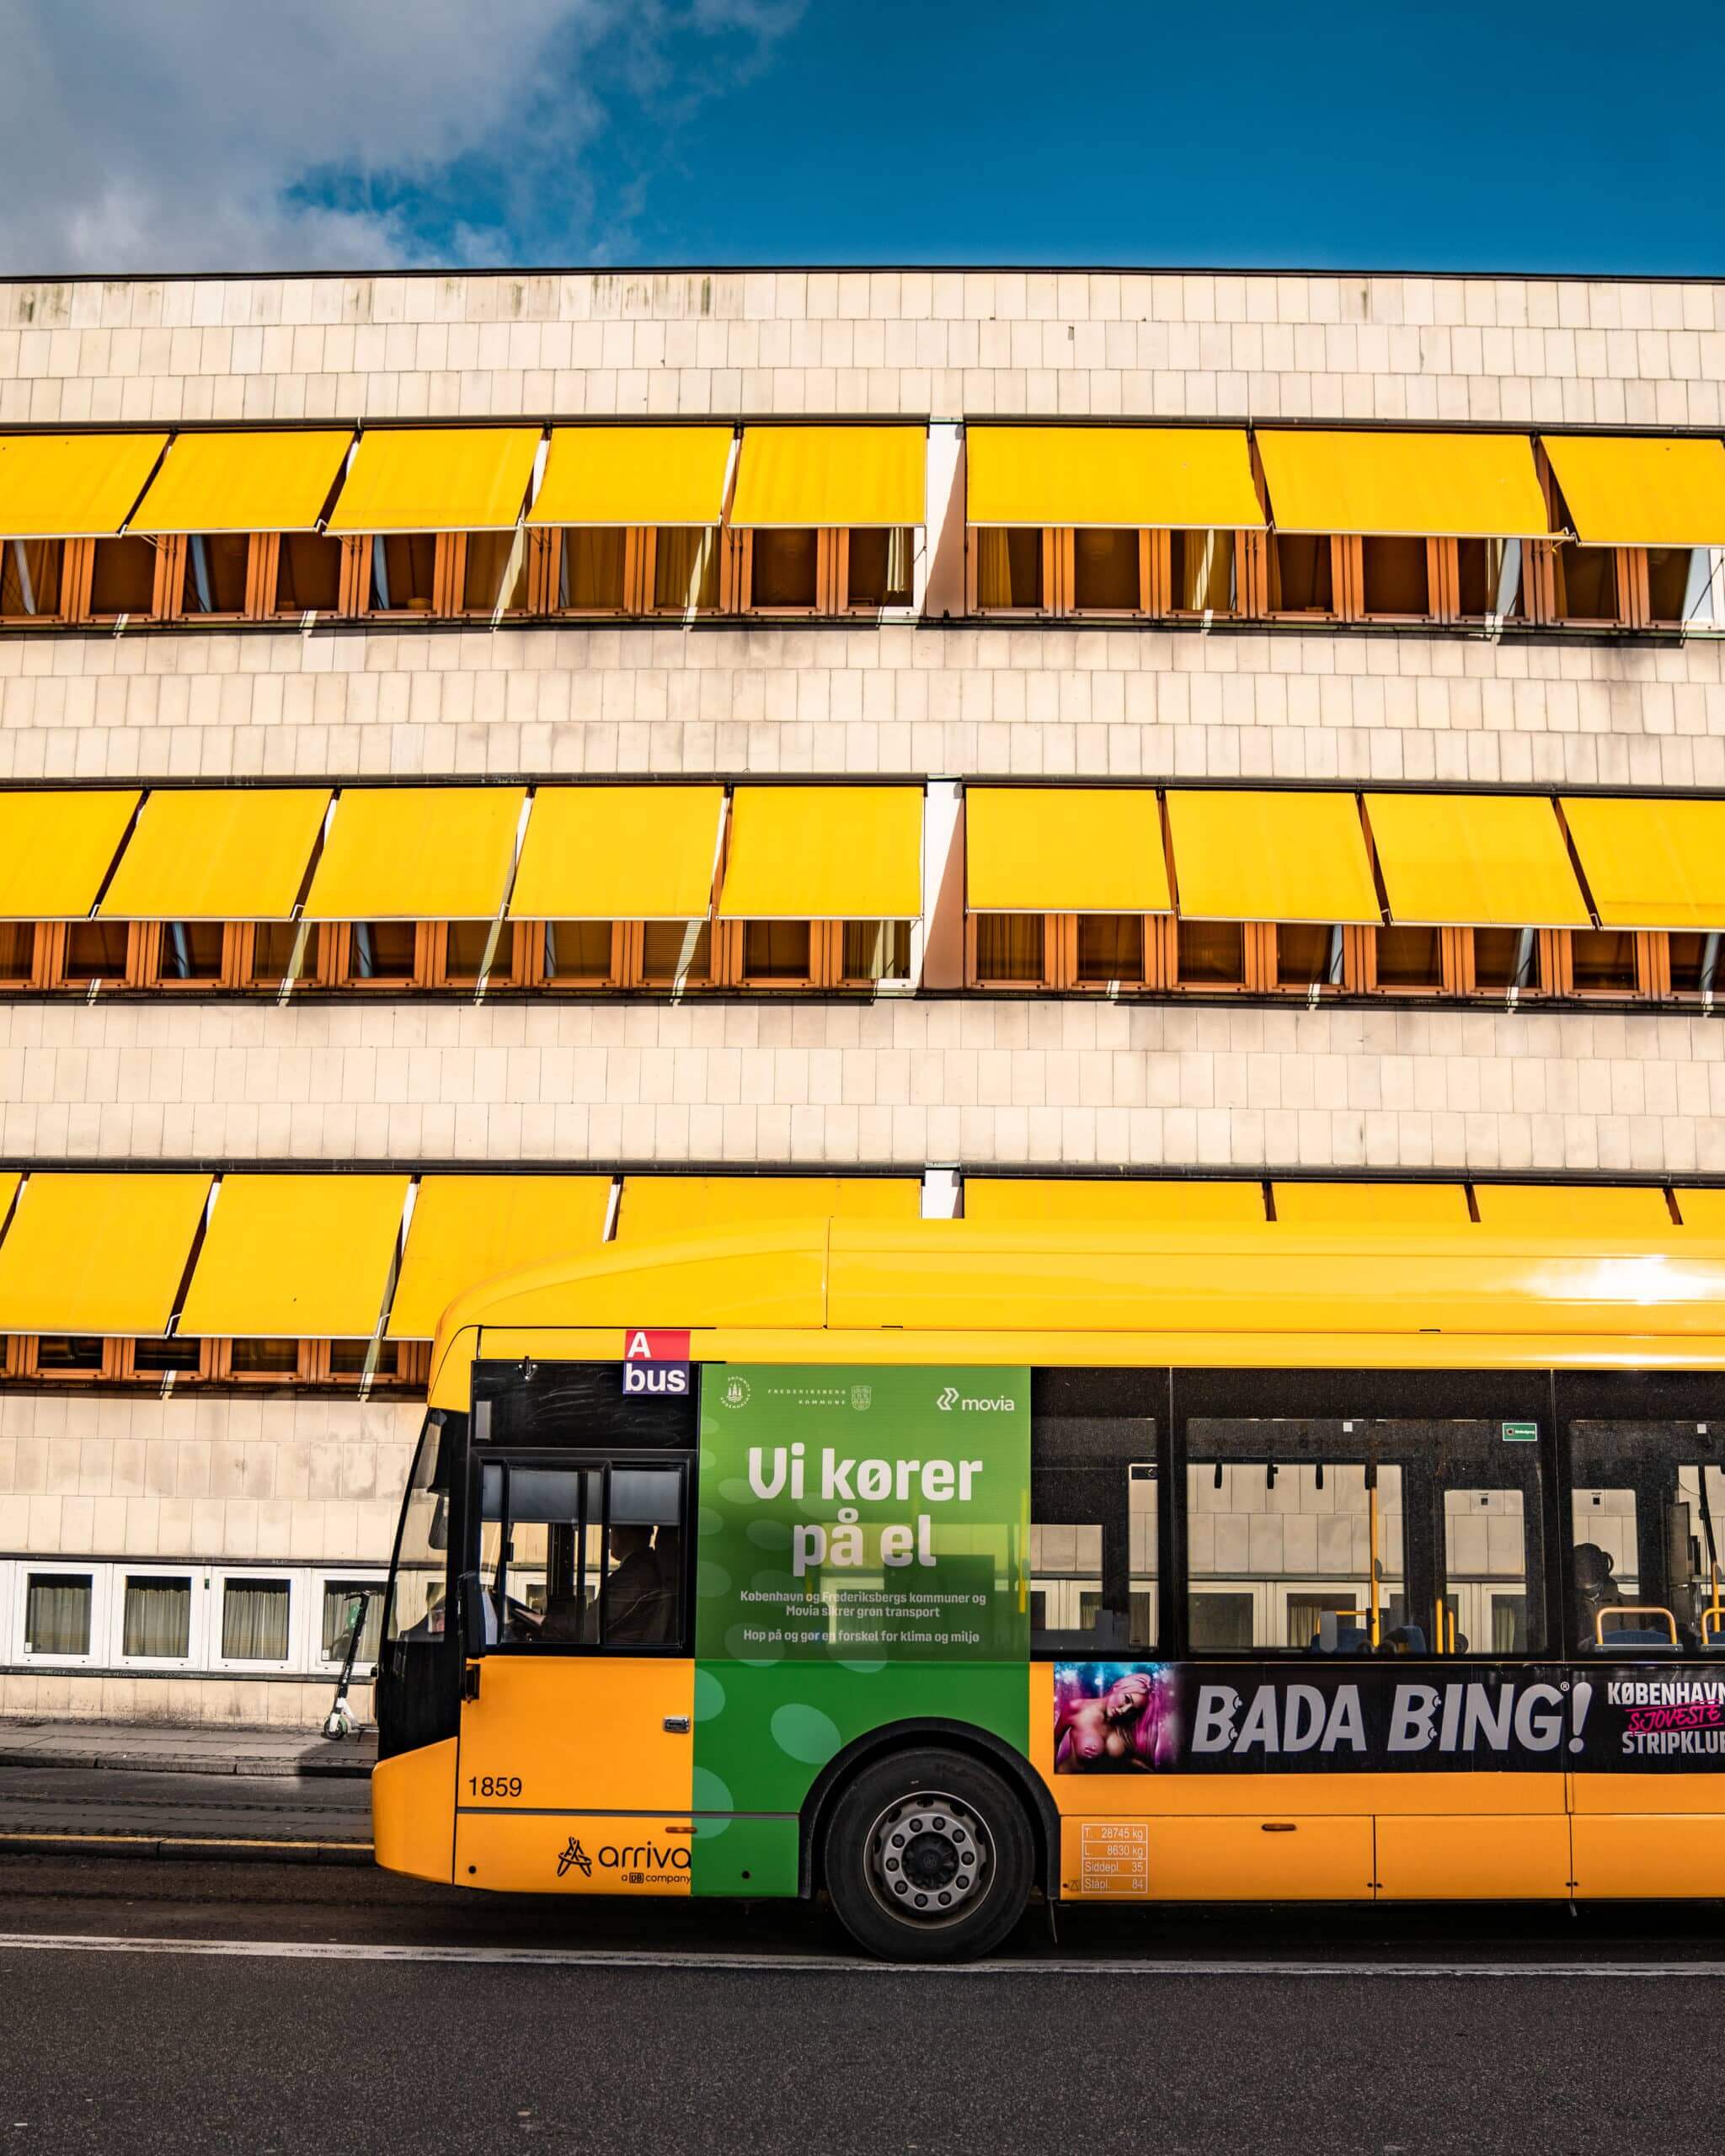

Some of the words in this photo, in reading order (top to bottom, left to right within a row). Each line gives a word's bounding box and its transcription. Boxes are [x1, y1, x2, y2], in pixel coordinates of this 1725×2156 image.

[628, 1331, 652, 1358] A
[626, 1363, 686, 1392] bus
[962, 1395, 1015, 1411] movia
[749, 1442, 805, 1500] Vi
[821, 1448, 983, 1501] kører
[793, 1508, 863, 1577] på
[880, 1514, 937, 1566] el
[740, 1590, 804, 1602] København
[805, 1593, 820, 1604] og
[821, 1591, 906, 1605] Frederiksbergs
[910, 1593, 969, 1604] kommuner
[972, 1594, 986, 1606] og
[786, 1604, 820, 1616] Movia
[884, 1607, 941, 1619] transport
[743, 1629, 766, 1641] Hop
[767, 1628, 782, 1641] på
[784, 1631, 798, 1642] og
[821, 1632, 836, 1641] en
[838, 1630, 879, 1641] forskel
[881, 1630, 899, 1641] for
[900, 1630, 932, 1642] klima
[934, 1633, 949, 1644] og
[1191, 1685, 1367, 1753] BADA
[1627, 1704, 1721, 1732] SJOVESTE
[468, 1776, 522, 1796] 1859
[1101, 1827, 1130, 1838] 28745
[1131, 1827, 1143, 1841] kg
[598, 1840, 692, 1869] arriva
[1107, 1844, 1130, 1856] 8630
[1131, 1845, 1143, 1860] kg
[1131, 1861, 1143, 1872] 35
[645, 1875, 692, 1885] company
[1131, 1879, 1143, 1889] 84
